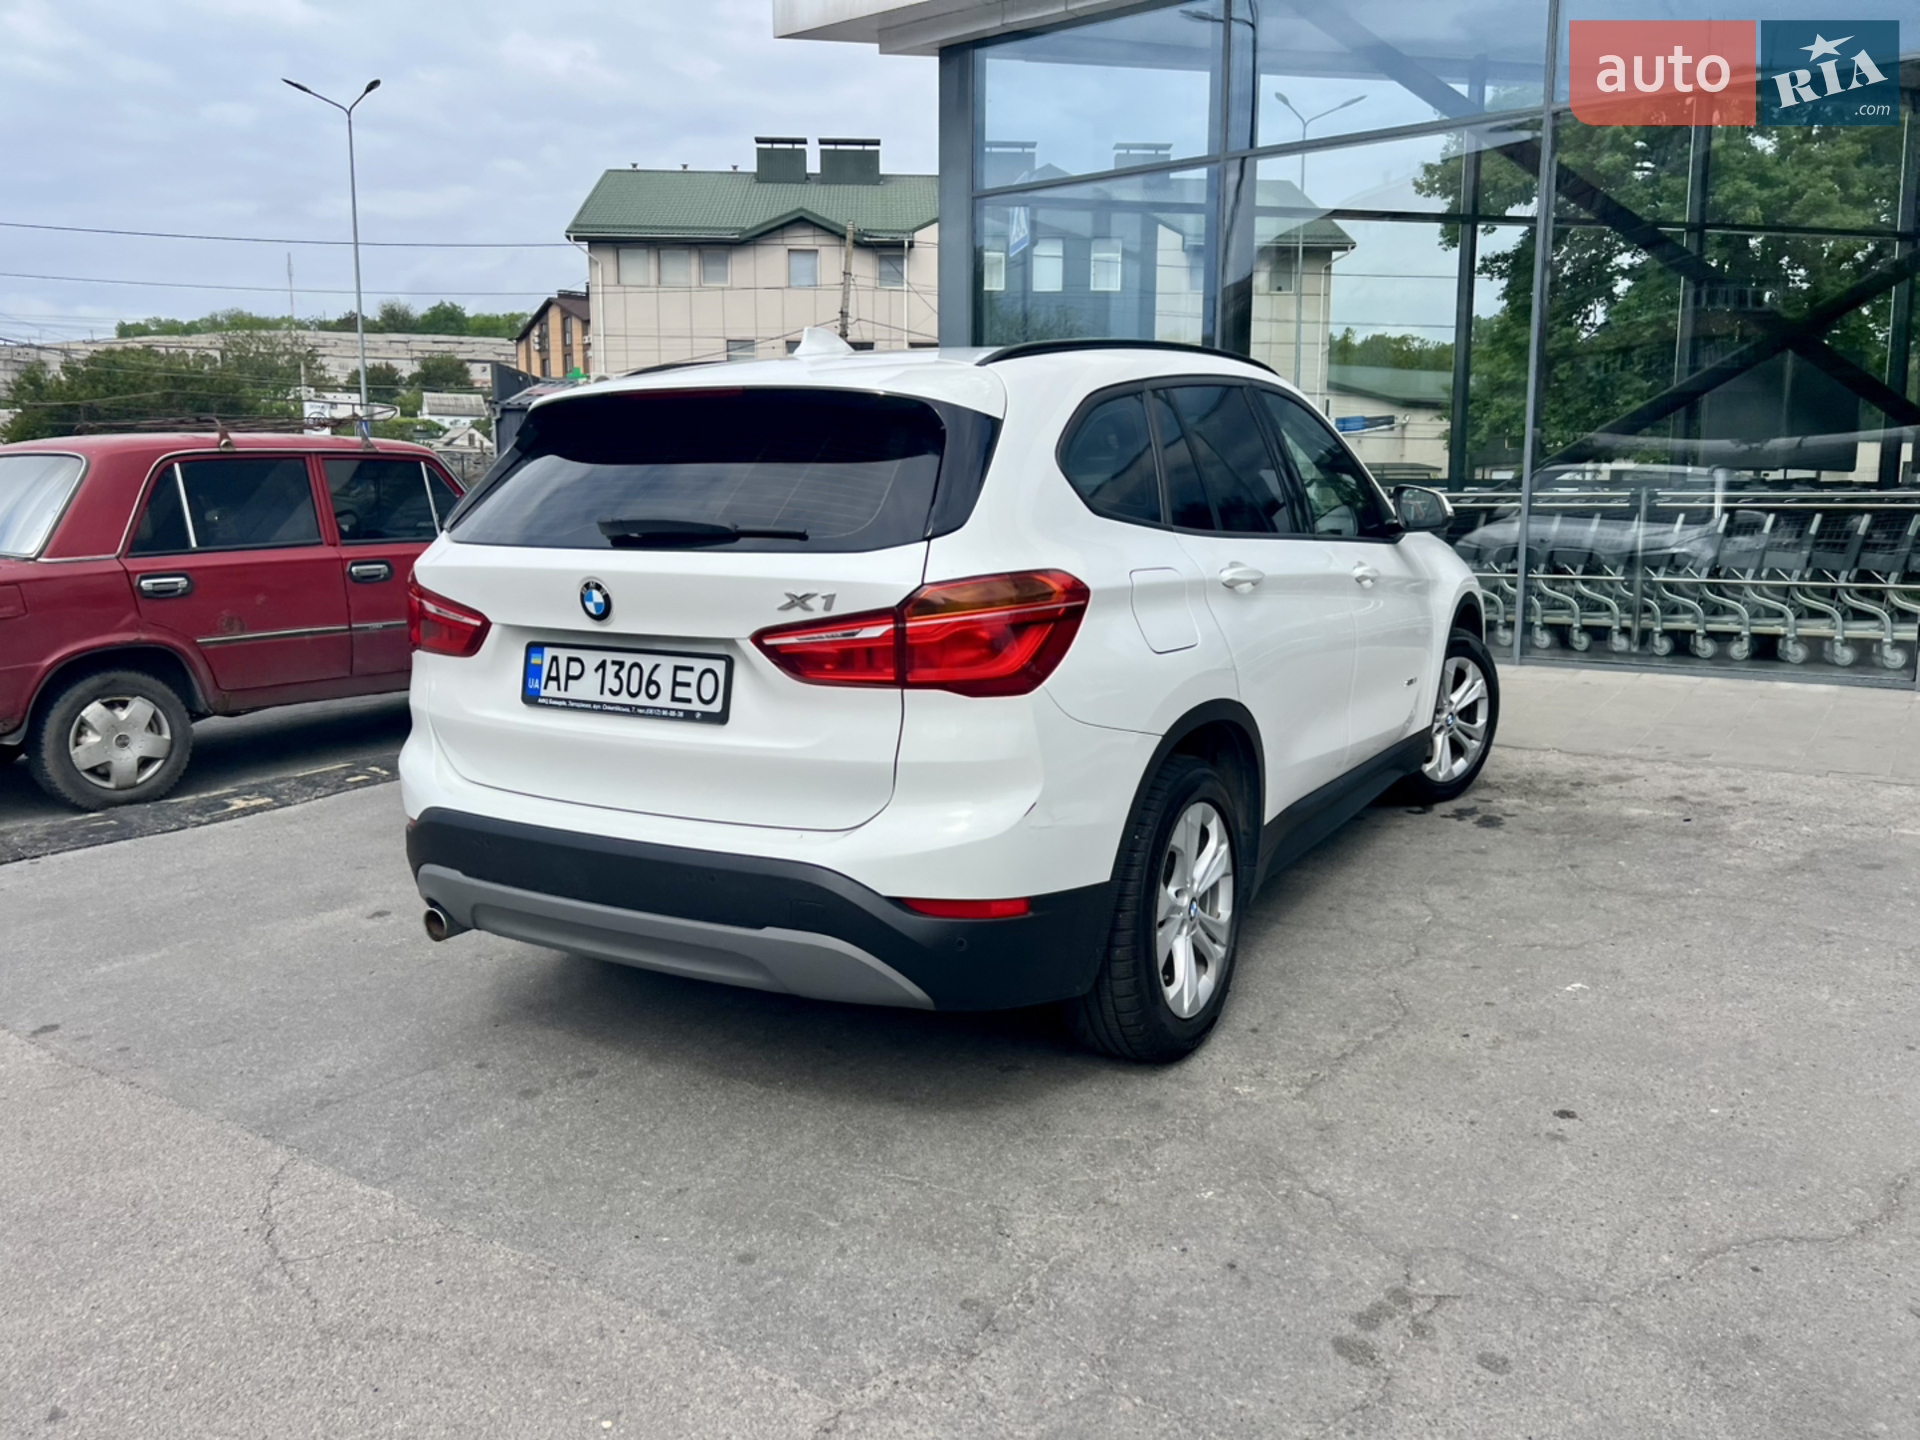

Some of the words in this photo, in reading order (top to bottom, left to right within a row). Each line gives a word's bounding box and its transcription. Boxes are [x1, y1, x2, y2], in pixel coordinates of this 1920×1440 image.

[777, 592, 837, 612] X1
[528, 678, 540, 689] UA
[543, 655, 585, 692] AP
[594, 659, 662, 700] 1306
[670, 665, 720, 706] EO
